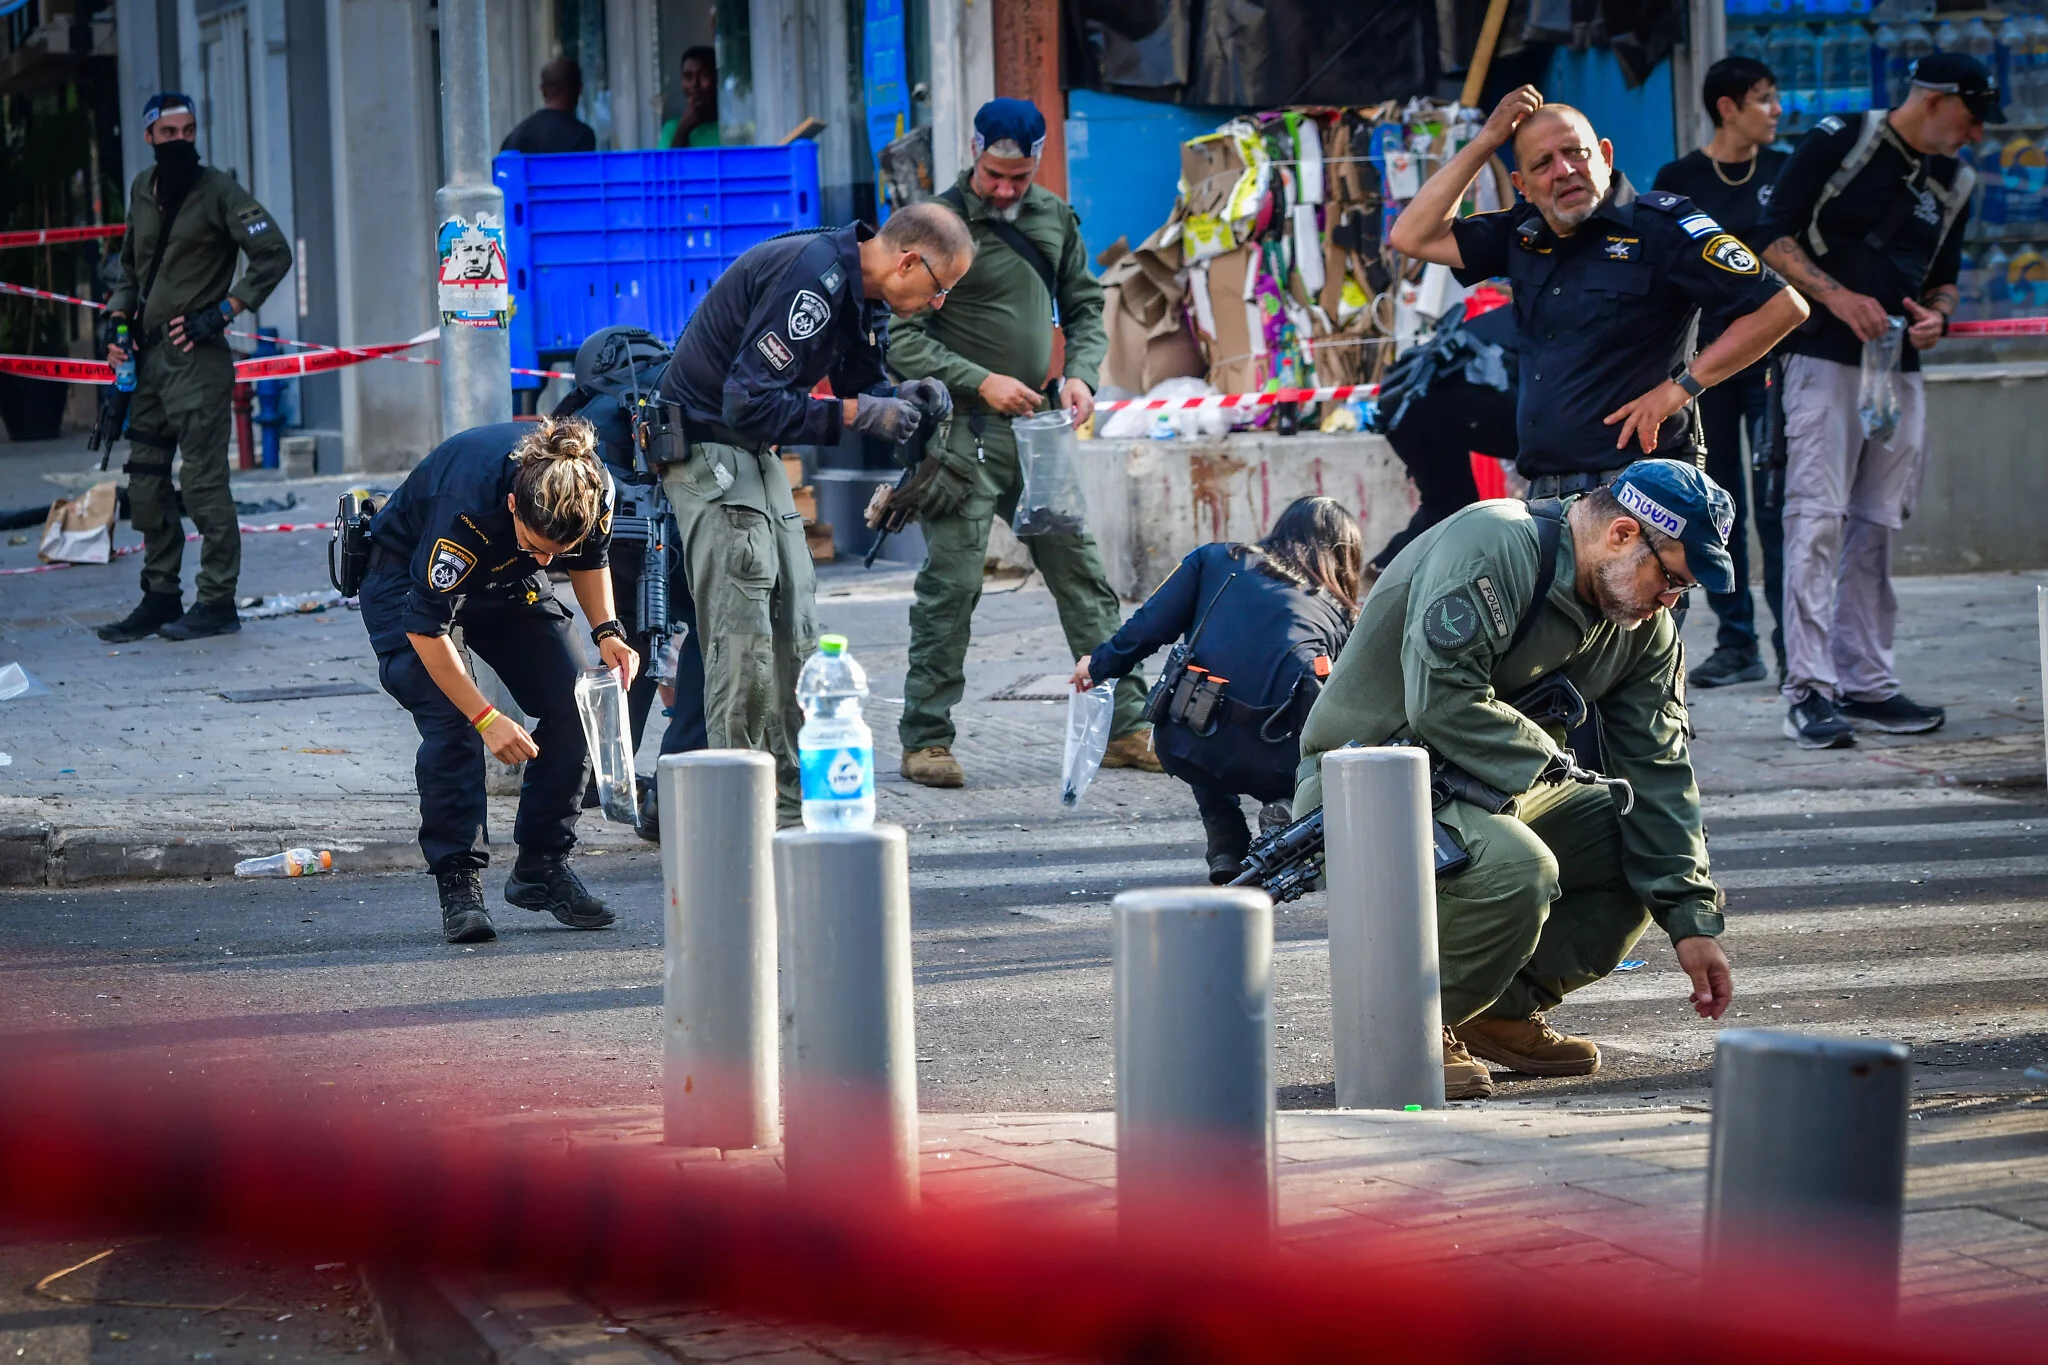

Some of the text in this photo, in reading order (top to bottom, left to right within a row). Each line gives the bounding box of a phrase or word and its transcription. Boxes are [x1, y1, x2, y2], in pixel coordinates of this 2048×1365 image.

[1622, 487, 1678, 532] משטרה
[441, 542, 457, 555] ישראל
[1482, 587, 1504, 627] POLICE
